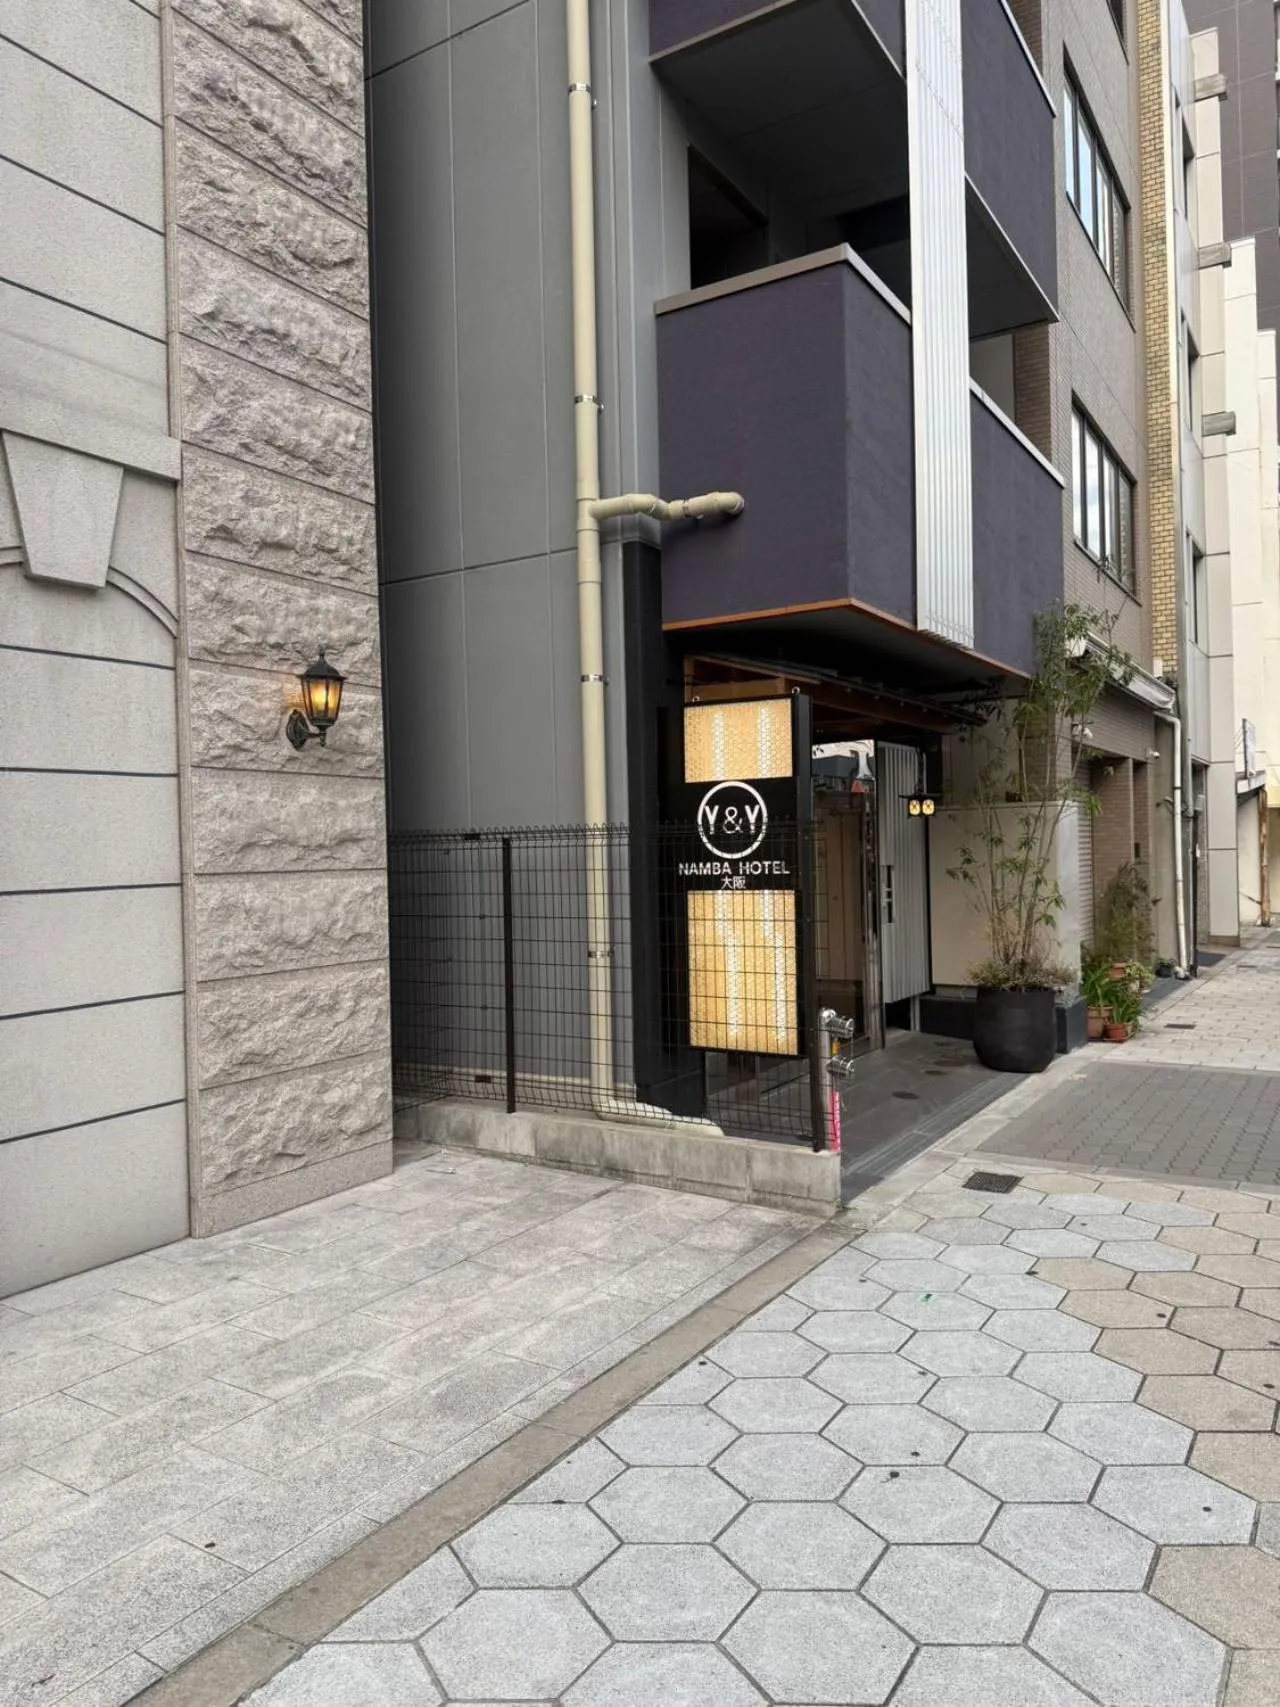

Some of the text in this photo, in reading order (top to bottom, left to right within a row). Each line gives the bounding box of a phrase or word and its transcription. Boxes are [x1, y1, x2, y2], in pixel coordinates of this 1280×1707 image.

[678, 860, 790, 875] NAMBA HOTEL
[721, 875, 746, 889] 大阪
